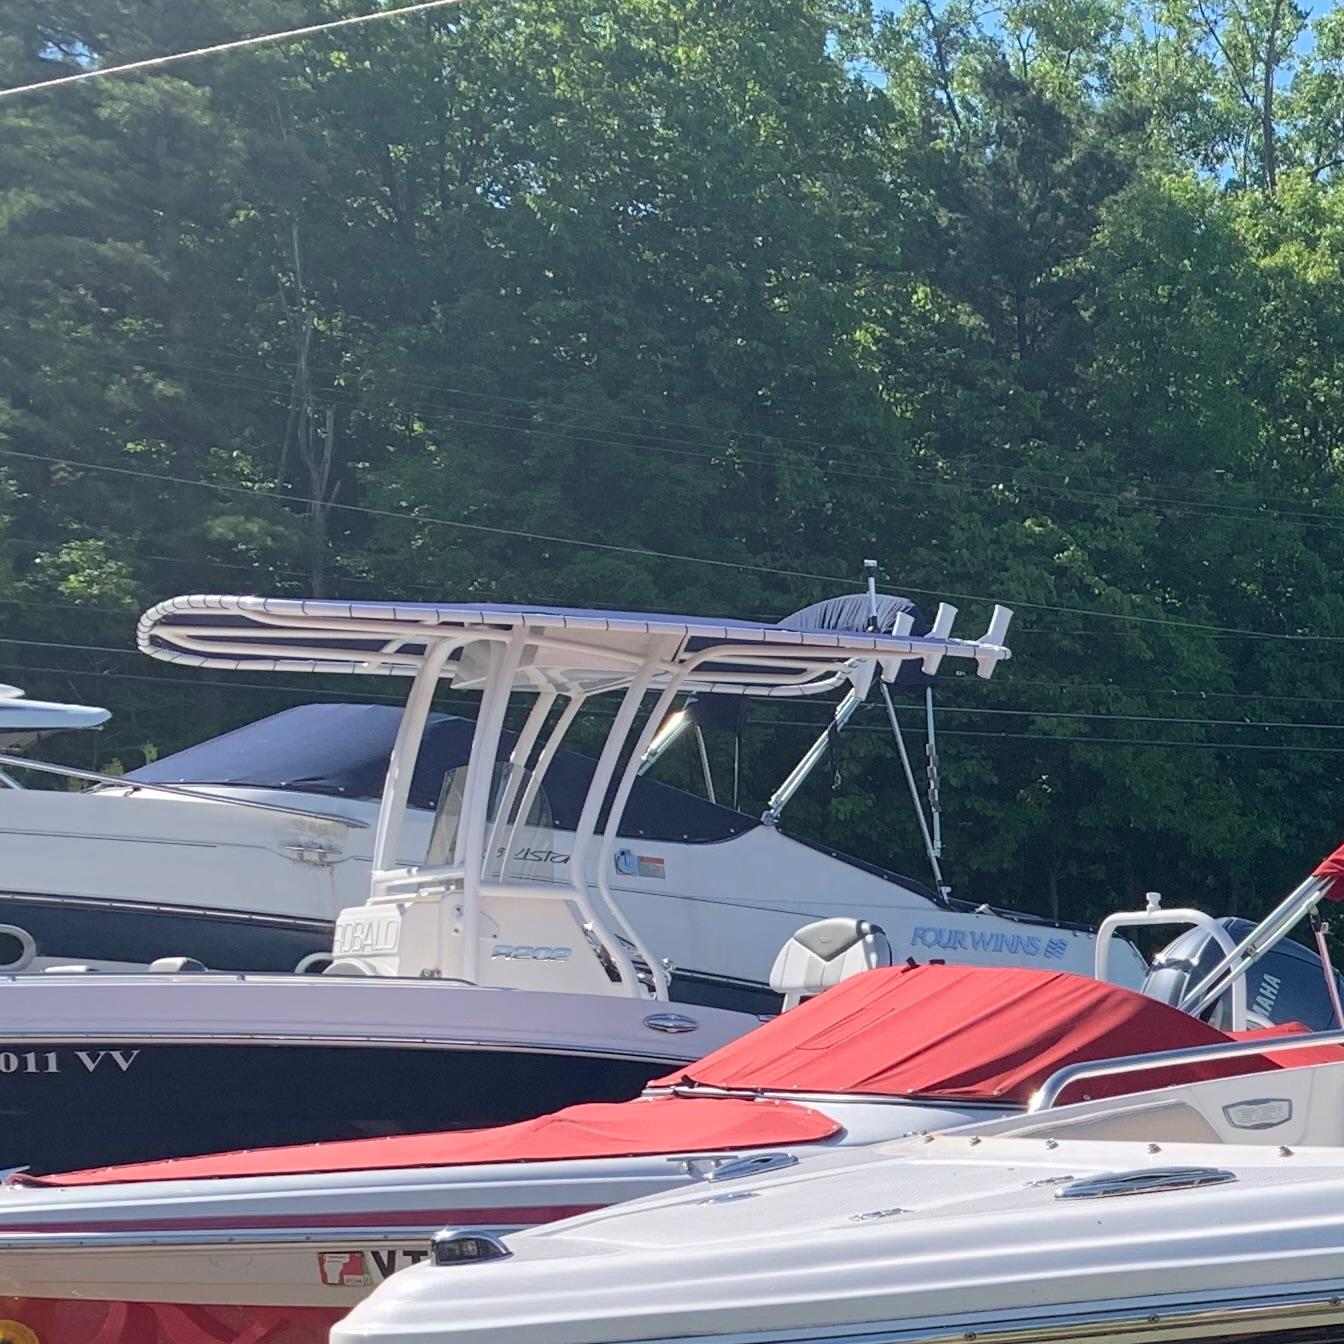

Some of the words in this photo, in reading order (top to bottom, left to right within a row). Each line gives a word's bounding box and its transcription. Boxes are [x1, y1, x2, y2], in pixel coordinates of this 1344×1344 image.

[911, 927, 966, 950] FOUR
[969, 931, 1041, 957] WINNS
[74, 1050, 141, 1073] VV
